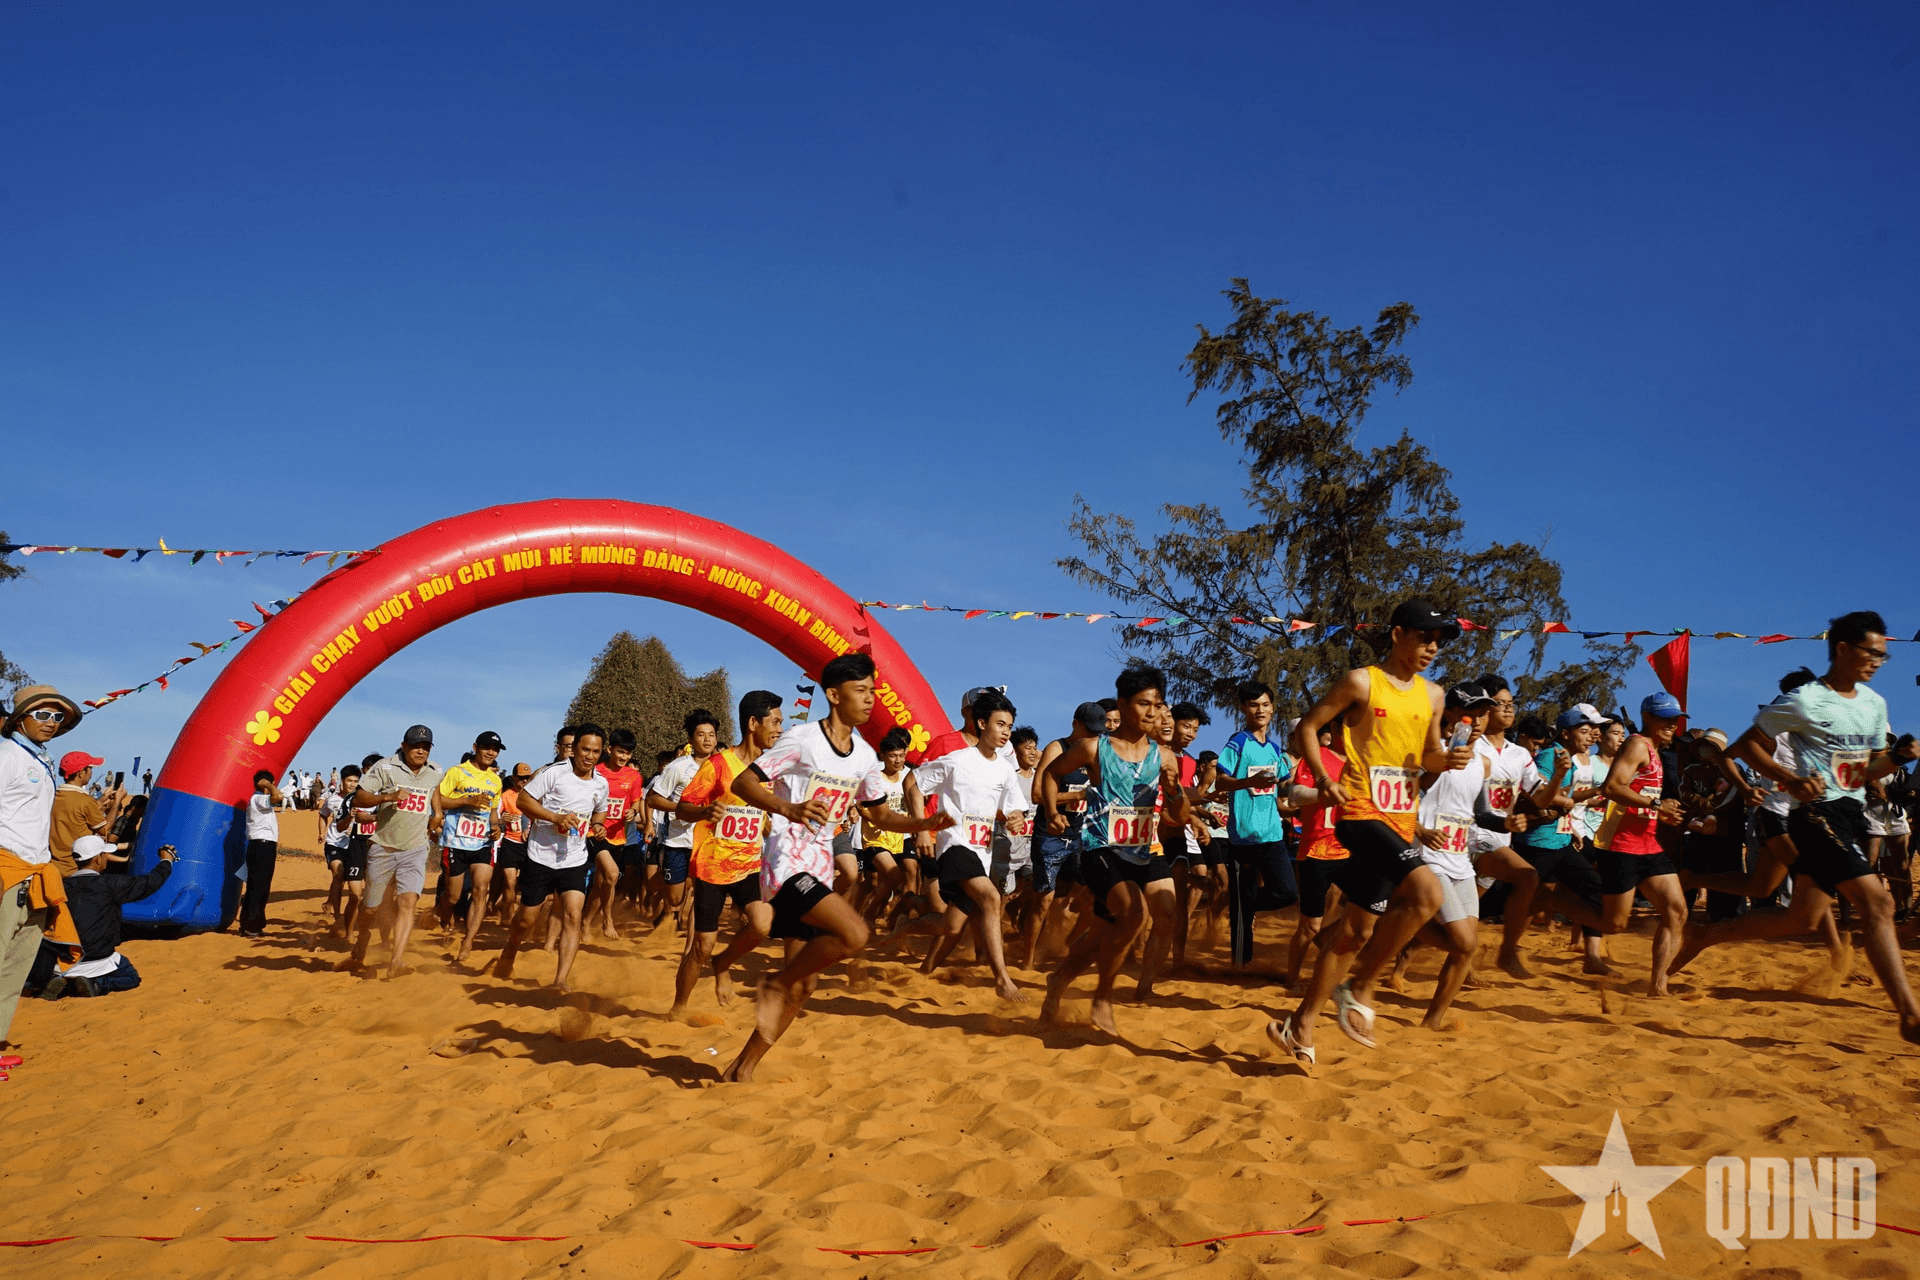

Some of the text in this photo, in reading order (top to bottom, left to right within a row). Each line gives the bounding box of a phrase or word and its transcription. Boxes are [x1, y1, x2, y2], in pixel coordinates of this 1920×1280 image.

[273, 669, 317, 715] GIẢI
[311, 624, 362, 674] CHẠY
[362, 591, 414, 633] VƯỢT
[416, 573, 455, 603] ĐỒI
[457, 556, 496, 585] CÁT
[502, 547, 542, 573] MŨI
[549, 543, 573, 566] NÉ
[580, 541, 637, 566] MỪNG
[642, 547, 695, 576] ĐẢNG
[707, 564, 763, 599] MỪNG
[763, 588, 812, 627] XUÂN
[809, 619, 852, 657] BÍNH
[875, 682, 912, 726] 2026
[461, 820, 485, 839] 012
[721, 814, 760, 841] 035
[1114, 818, 1150, 844] 014
[349, 867, 360, 876] 27
